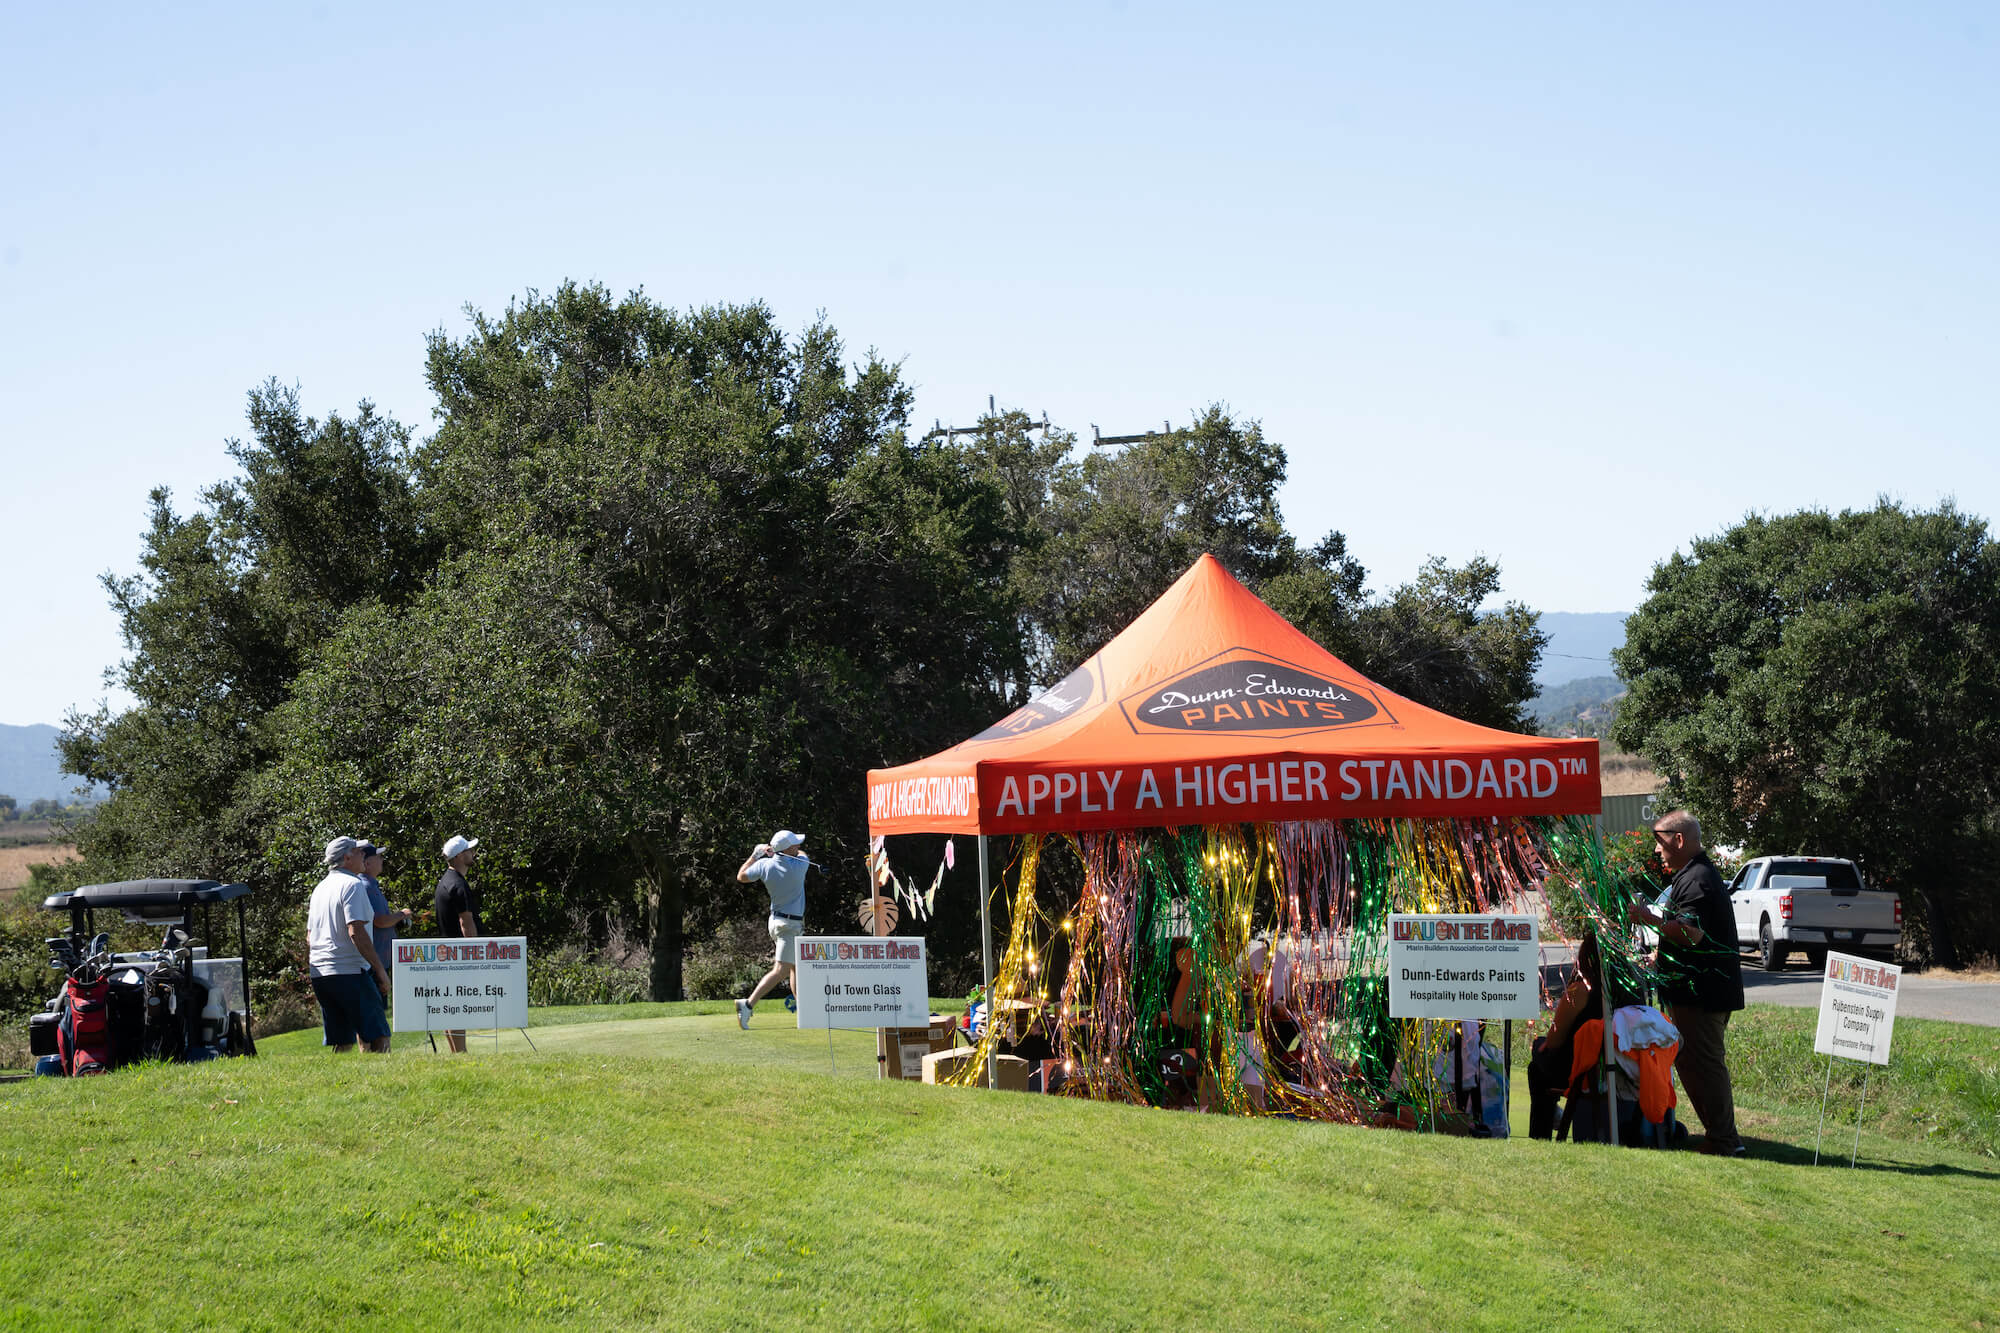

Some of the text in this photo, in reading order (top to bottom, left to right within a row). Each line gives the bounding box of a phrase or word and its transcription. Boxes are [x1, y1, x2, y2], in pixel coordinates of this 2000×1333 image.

[1149, 673, 1351, 714] Dunn-Edwards
[1181, 698, 1345, 727] PAINTS
[996, 769, 1123, 816] APPLY
[1135, 768, 1163, 809] A
[1174, 761, 1329, 807] HIGHER
[870, 783, 891, 821] APPLY
[891, 781, 898, 818] A
[898, 777, 927, 817] HIGHER
[1393, 921, 1435, 941] LUAU
[1436, 920, 1459, 940] ON
[1461, 923, 1489, 940] THE
[398, 945, 436, 963] LUAU
[437, 944, 457, 961] ON
[460, 945, 484, 960] THE
[800, 943, 838, 960] LUAU
[838, 943, 859, 960] ON
[860, 944, 884, 960] THE
[1402, 968, 1525, 982] Dunn-Edwards Paints
[414, 985, 507, 998] Mark J. Rice, Esq.
[824, 984, 901, 996] Old Town Glass
[1410, 990, 1517, 1003] Hospitality Hole Sponsor
[427, 1004, 494, 1015] Tee Sign Sponsor
[824, 1003, 902, 1013] Cornerstone Partner
[1832, 998, 1886, 1023] Rubenstein Supply
[1843, 1016, 1871, 1035] Company
